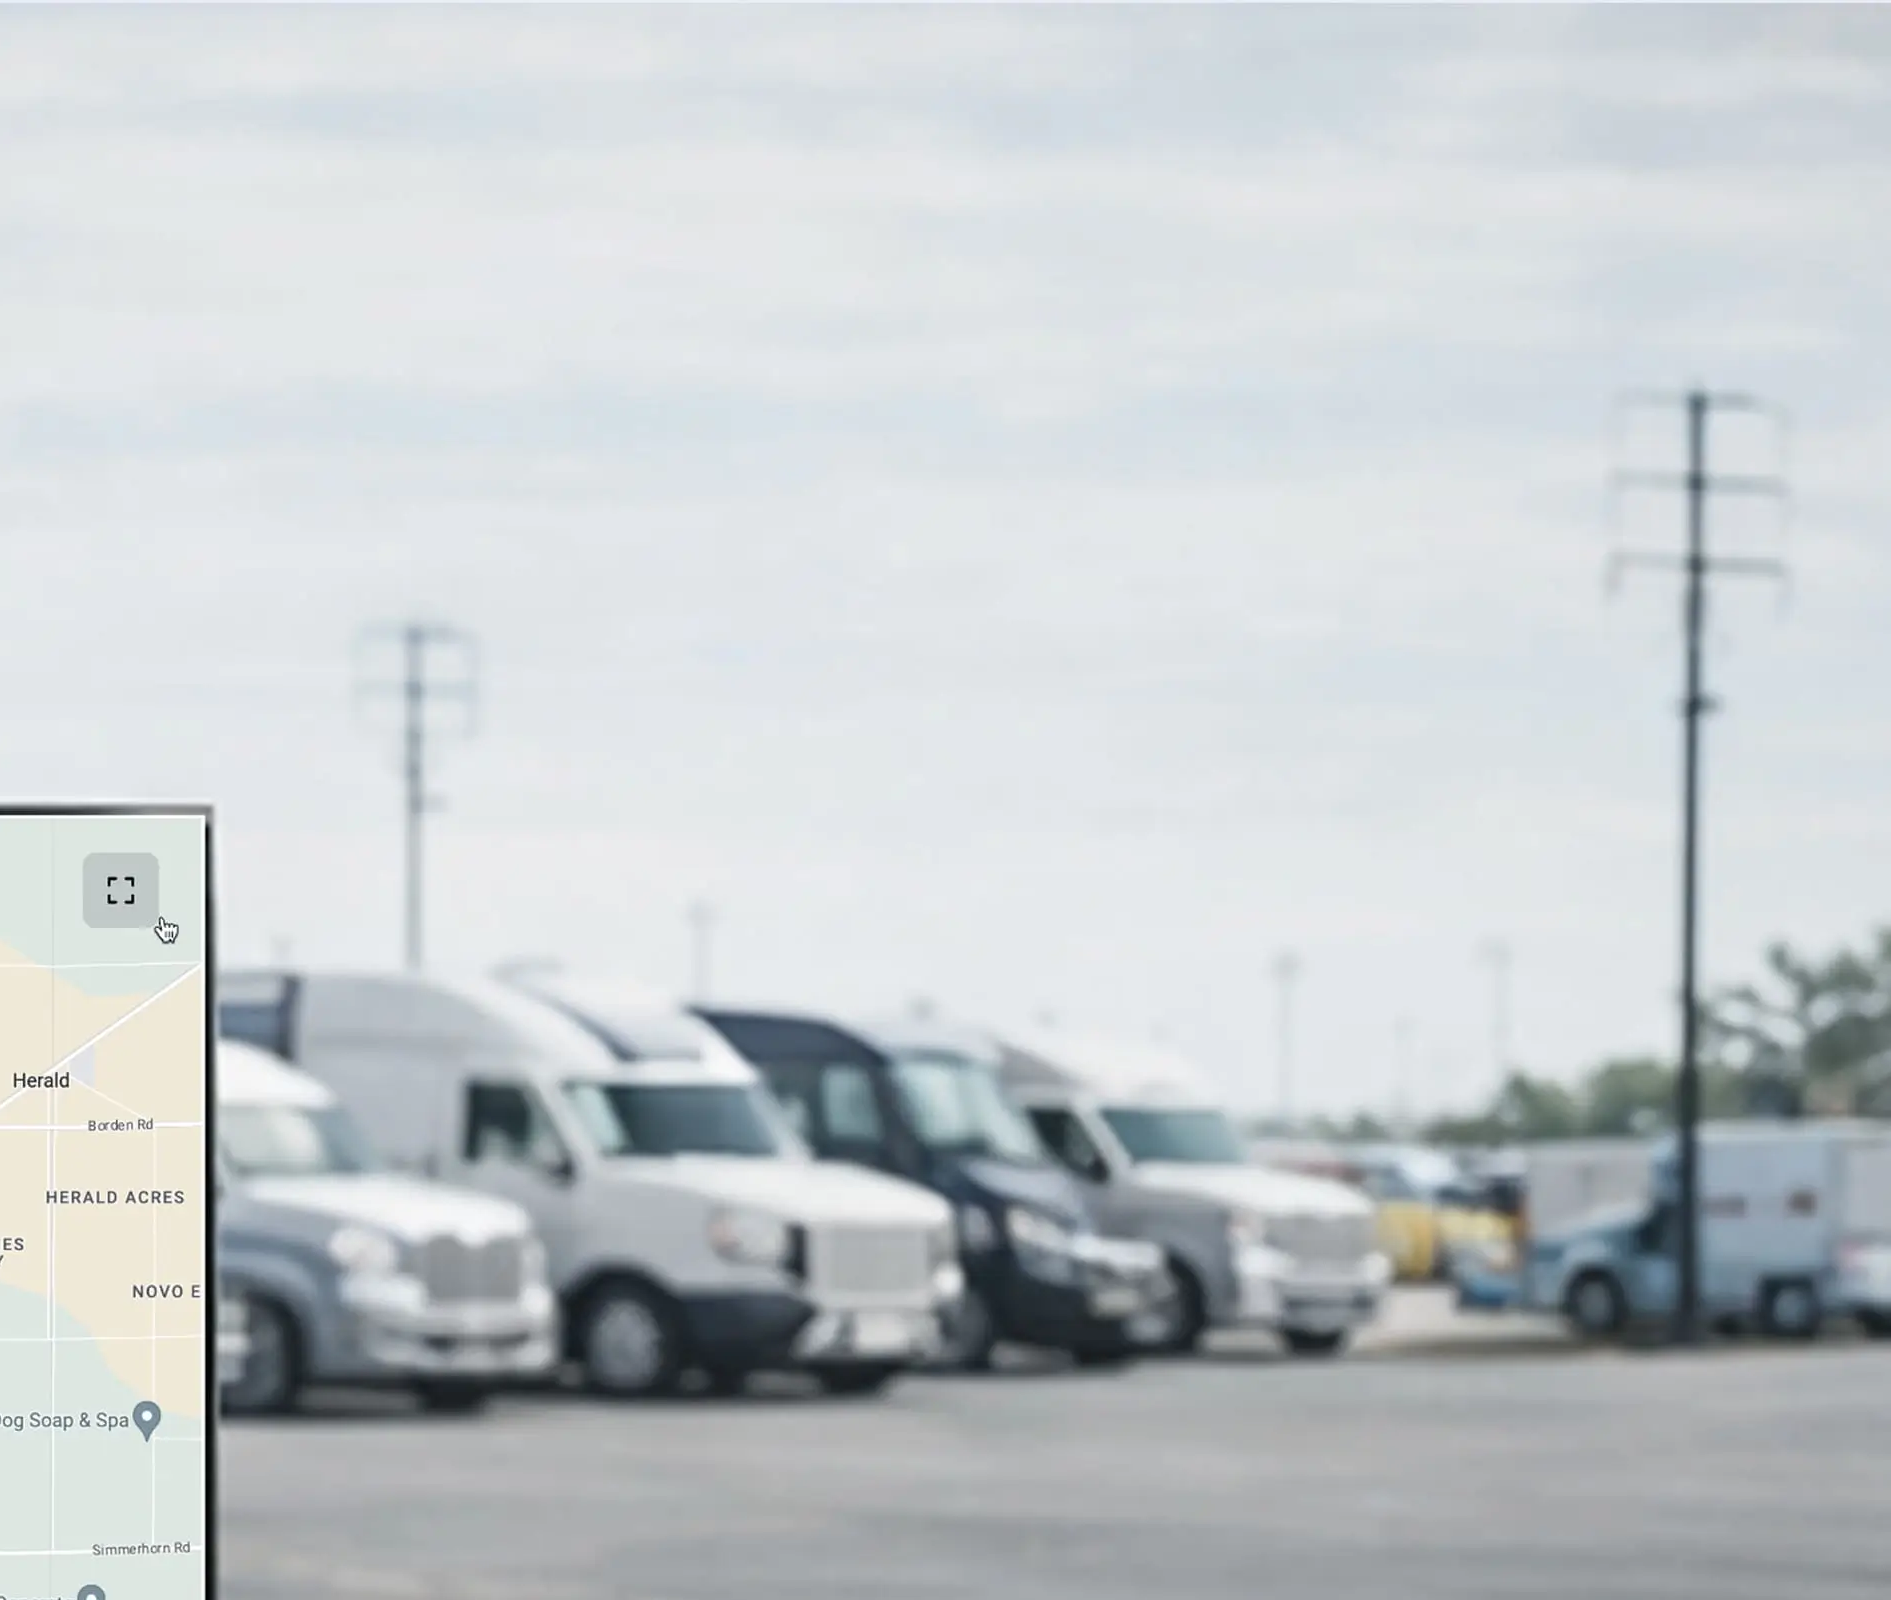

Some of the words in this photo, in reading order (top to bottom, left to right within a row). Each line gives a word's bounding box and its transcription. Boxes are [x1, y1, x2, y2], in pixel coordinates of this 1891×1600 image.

[13, 1071, 70, 1089] Herald
[88, 1119, 134, 1132] Borden
[137, 1118, 154, 1130] Rd
[46, 1190, 118, 1205] HERALD
[125, 1190, 185, 1205] ACRES
[29, 1411, 74, 1432] Soap
[79, 1412, 91, 1428] &
[96, 1412, 129, 1432] Spa
